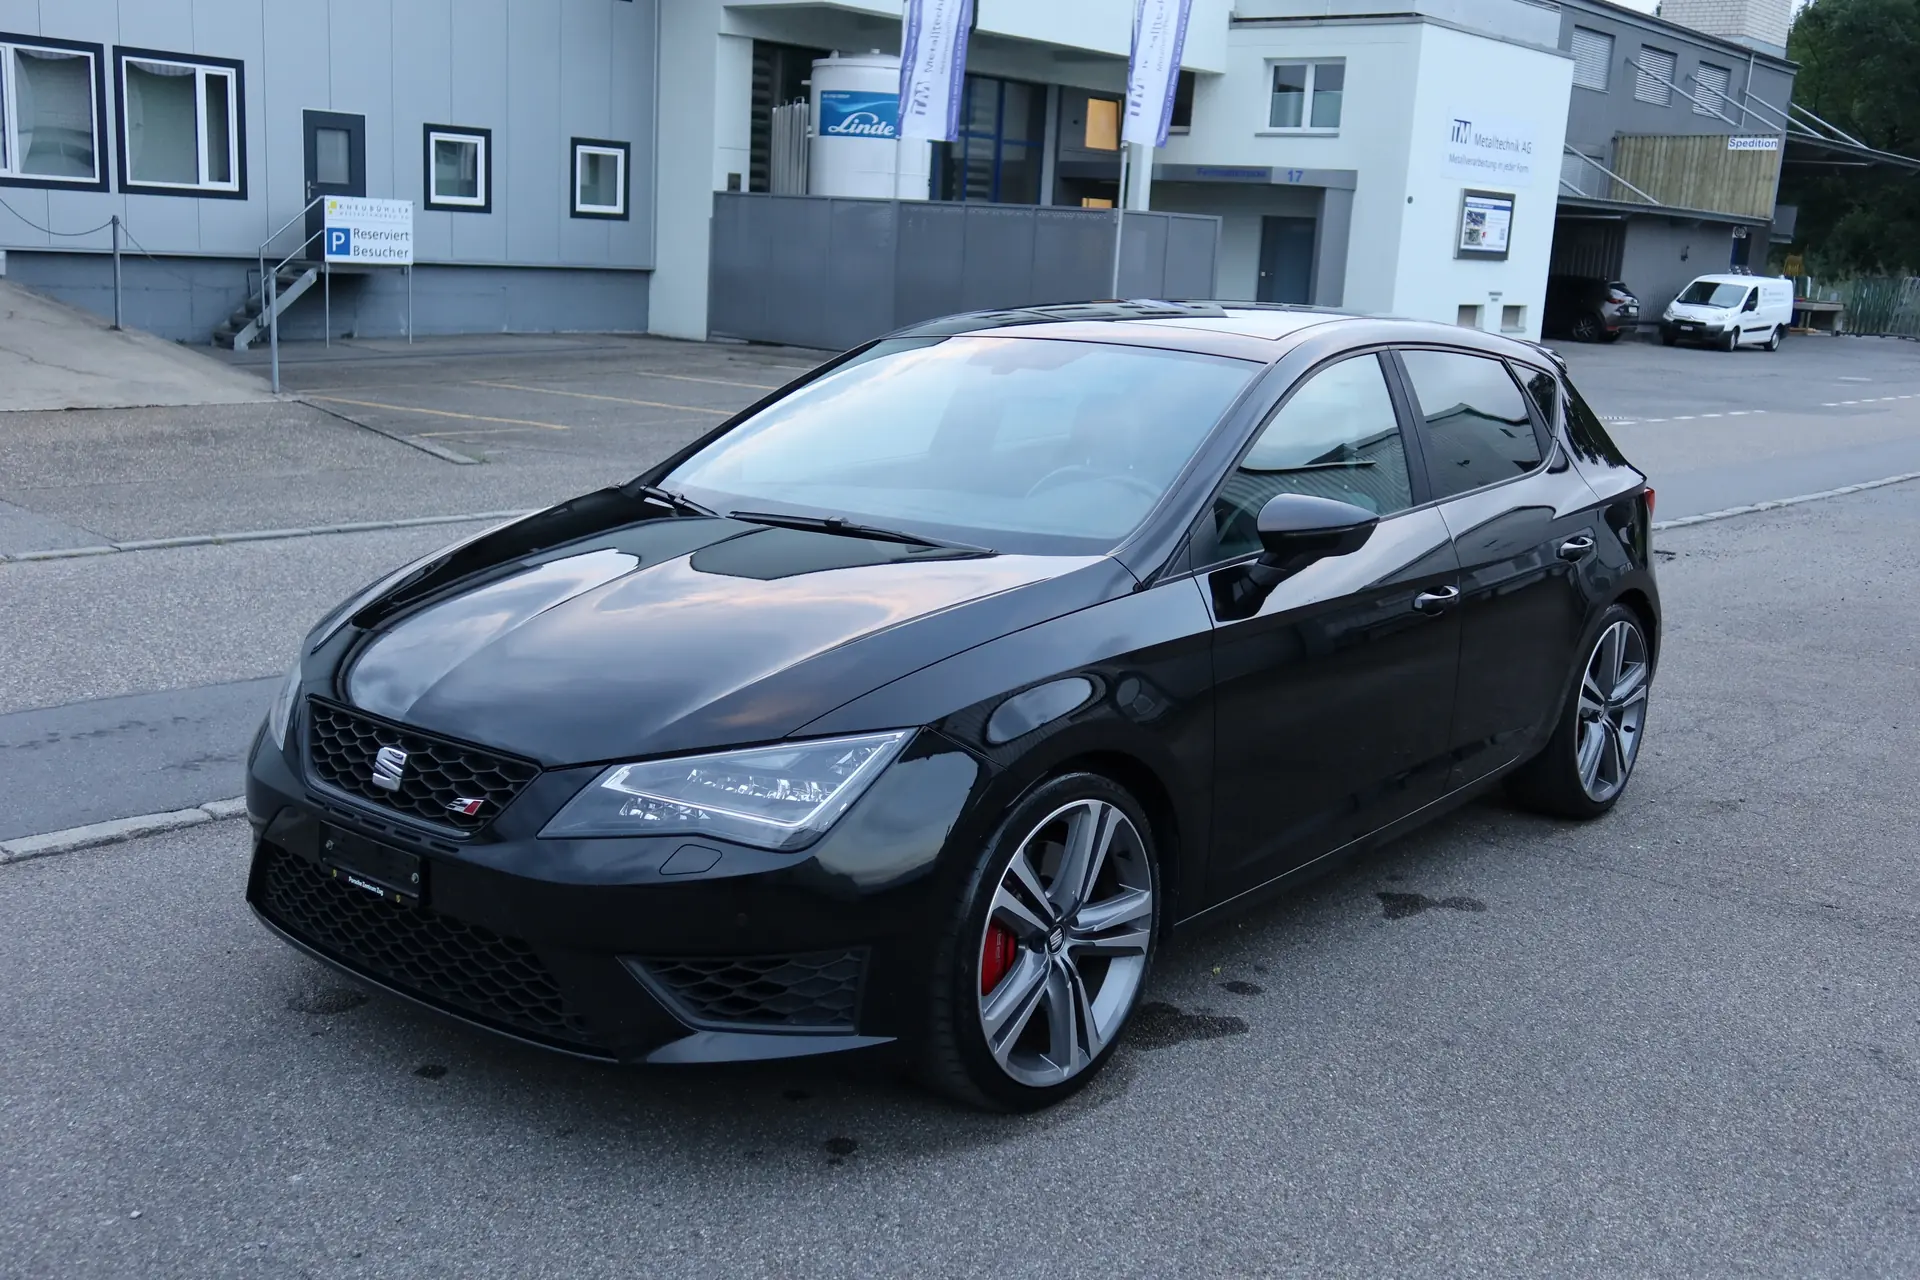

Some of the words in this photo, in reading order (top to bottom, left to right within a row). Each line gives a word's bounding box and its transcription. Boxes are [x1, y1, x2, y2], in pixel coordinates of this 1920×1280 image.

[828, 112, 895, 135] Linde
[1474, 133, 1520, 152] Metalltechnik
[1521, 140, 1533, 154] AG
[1729, 138, 1777, 149] Spedition
[1287, 169, 1303, 182] 17
[353, 228, 410, 241] Reserviert
[332, 231, 346, 252] P
[353, 245, 409, 258] Besucher
